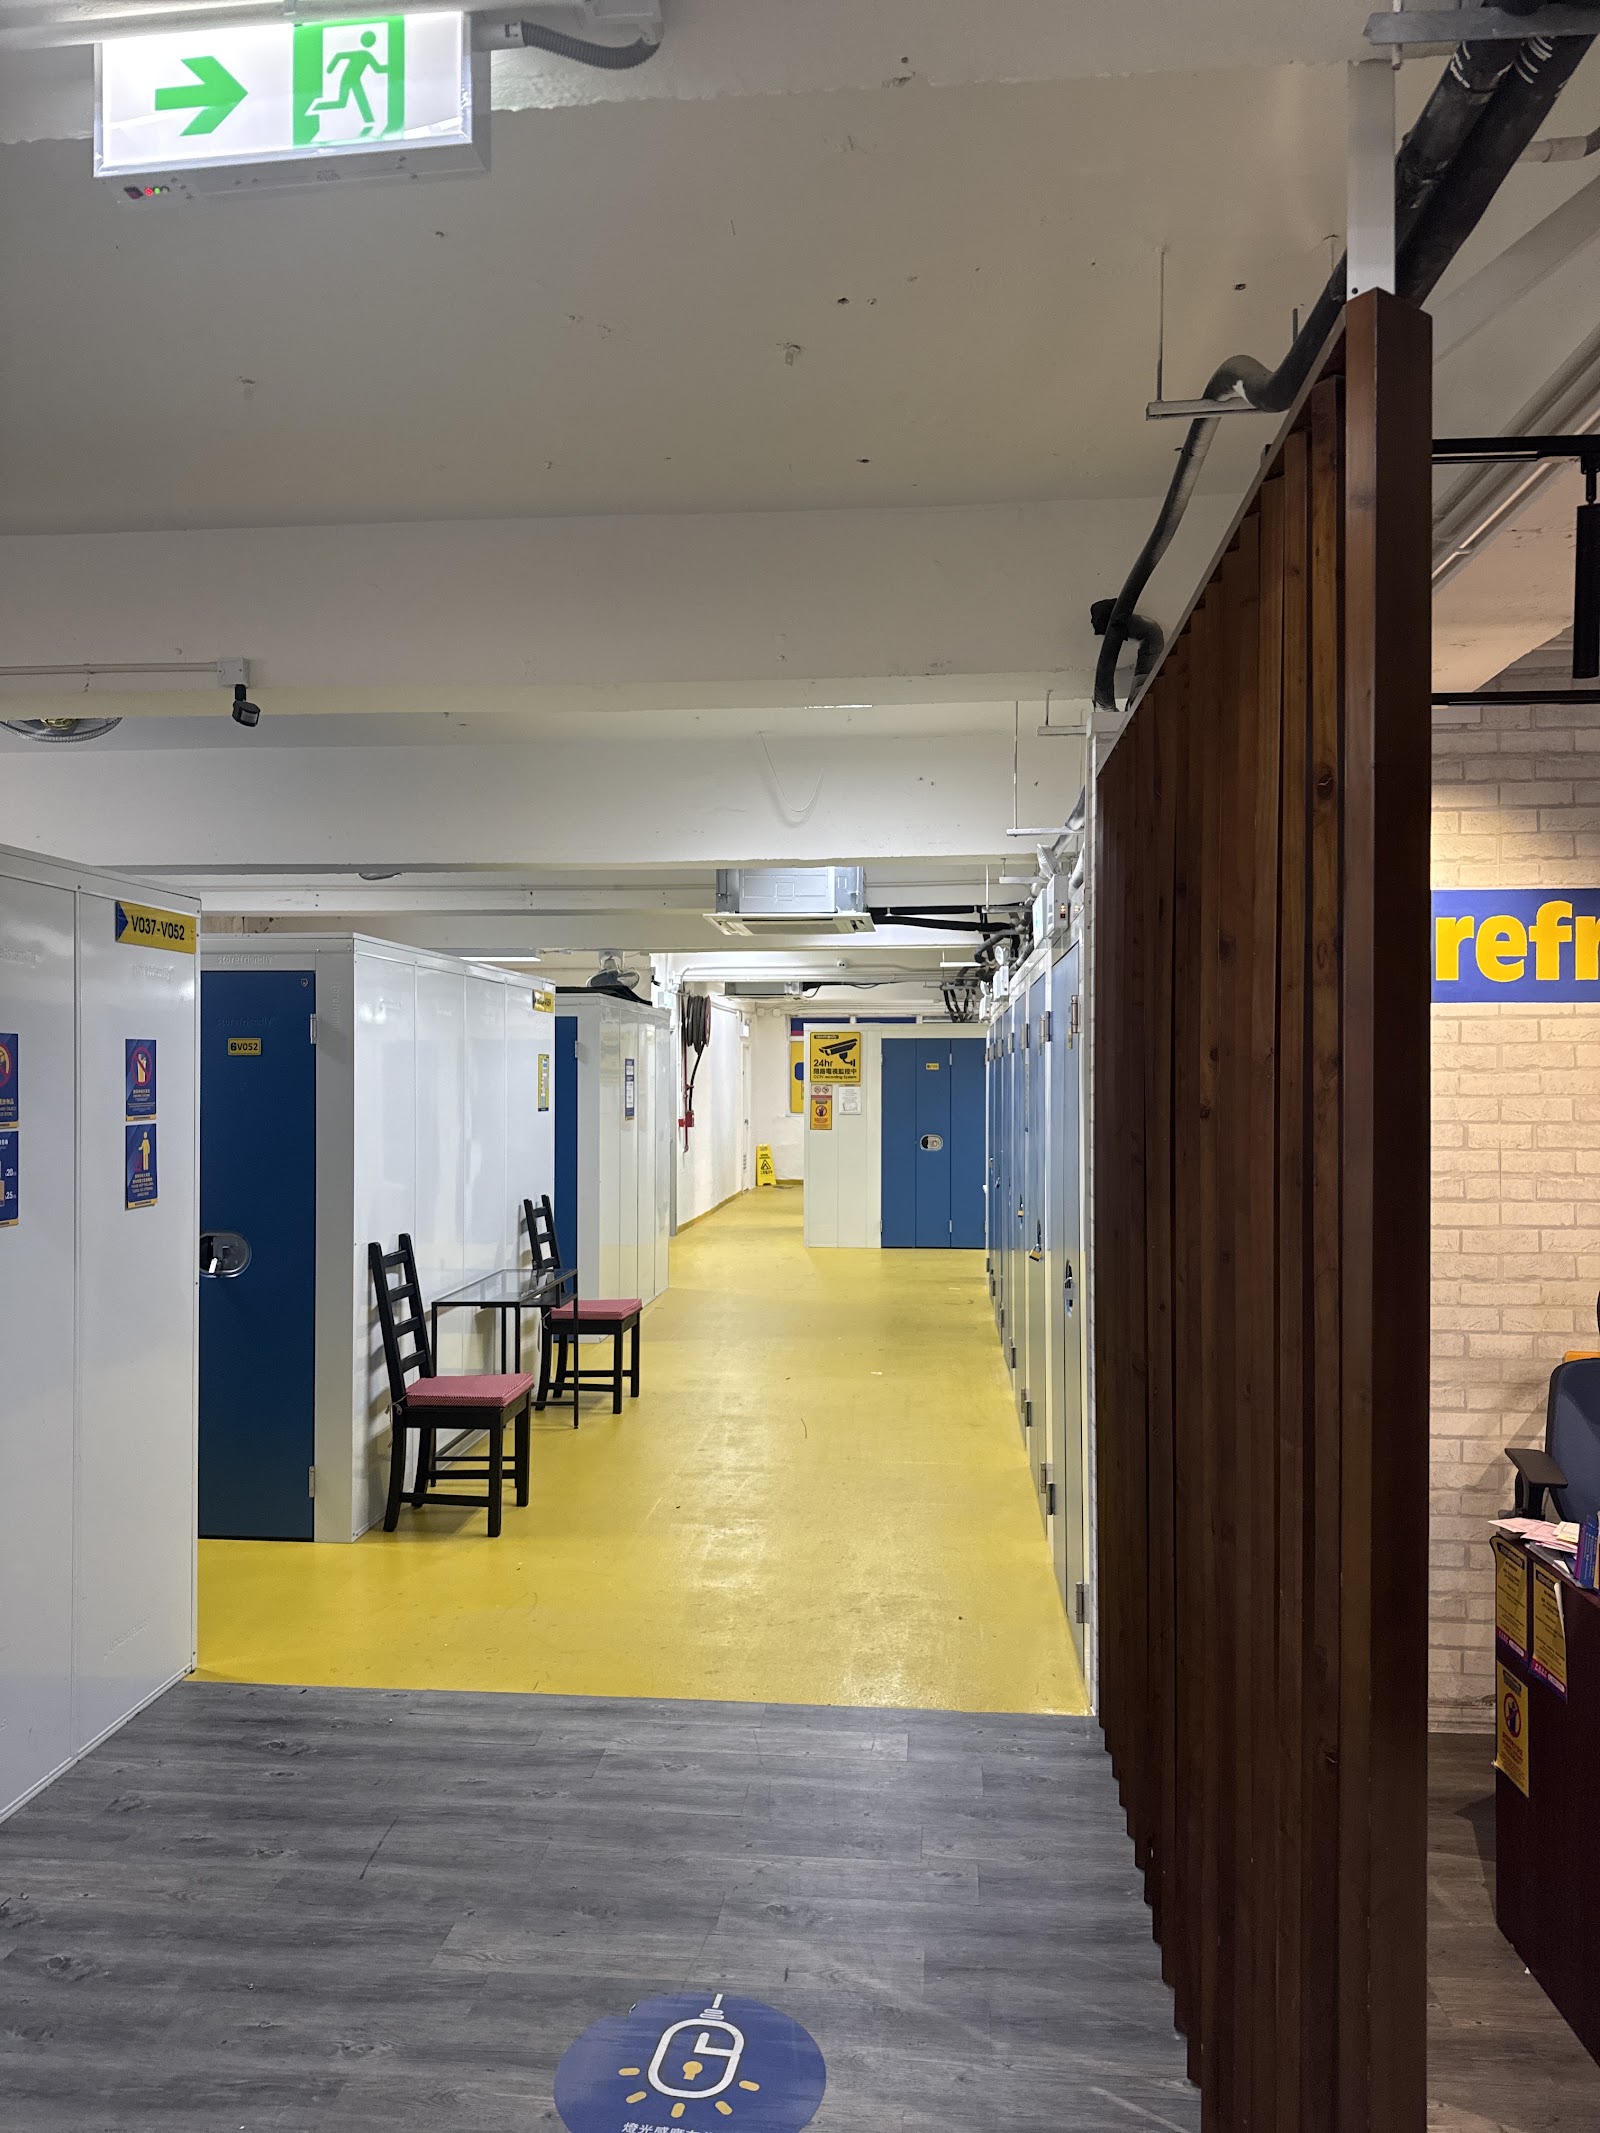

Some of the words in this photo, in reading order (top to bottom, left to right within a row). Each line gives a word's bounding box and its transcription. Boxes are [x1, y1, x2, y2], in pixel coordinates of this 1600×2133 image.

[130, 914, 185, 941] V037-V052
[230, 1041, 258, 1052] 6V052
[813, 1059, 833, 1067] 24hr
